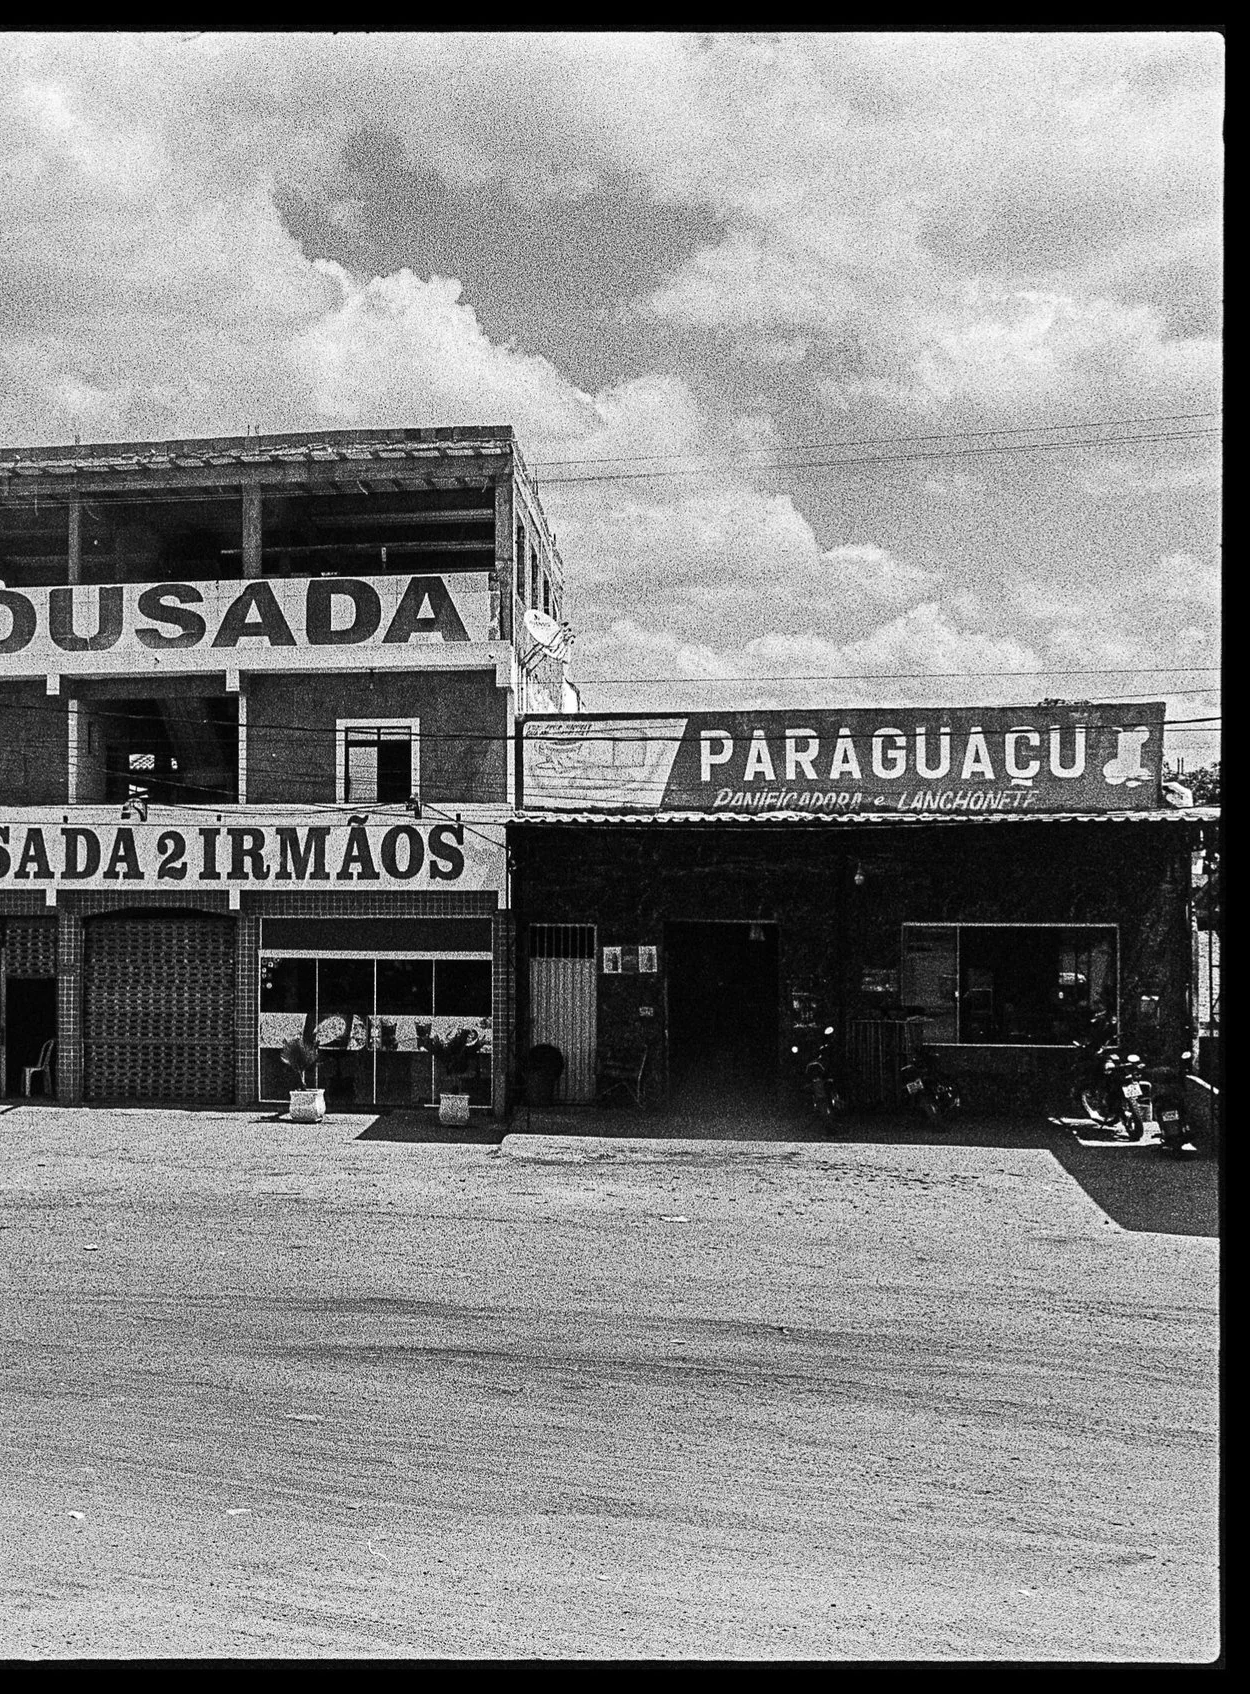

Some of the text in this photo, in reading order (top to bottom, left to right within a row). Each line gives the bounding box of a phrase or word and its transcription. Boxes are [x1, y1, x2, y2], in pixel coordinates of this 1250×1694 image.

[699, 725, 1087, 786] PARAGUAÇU
[157, 830, 188, 880] 2
[198, 815, 465, 880] IRMÃOS
